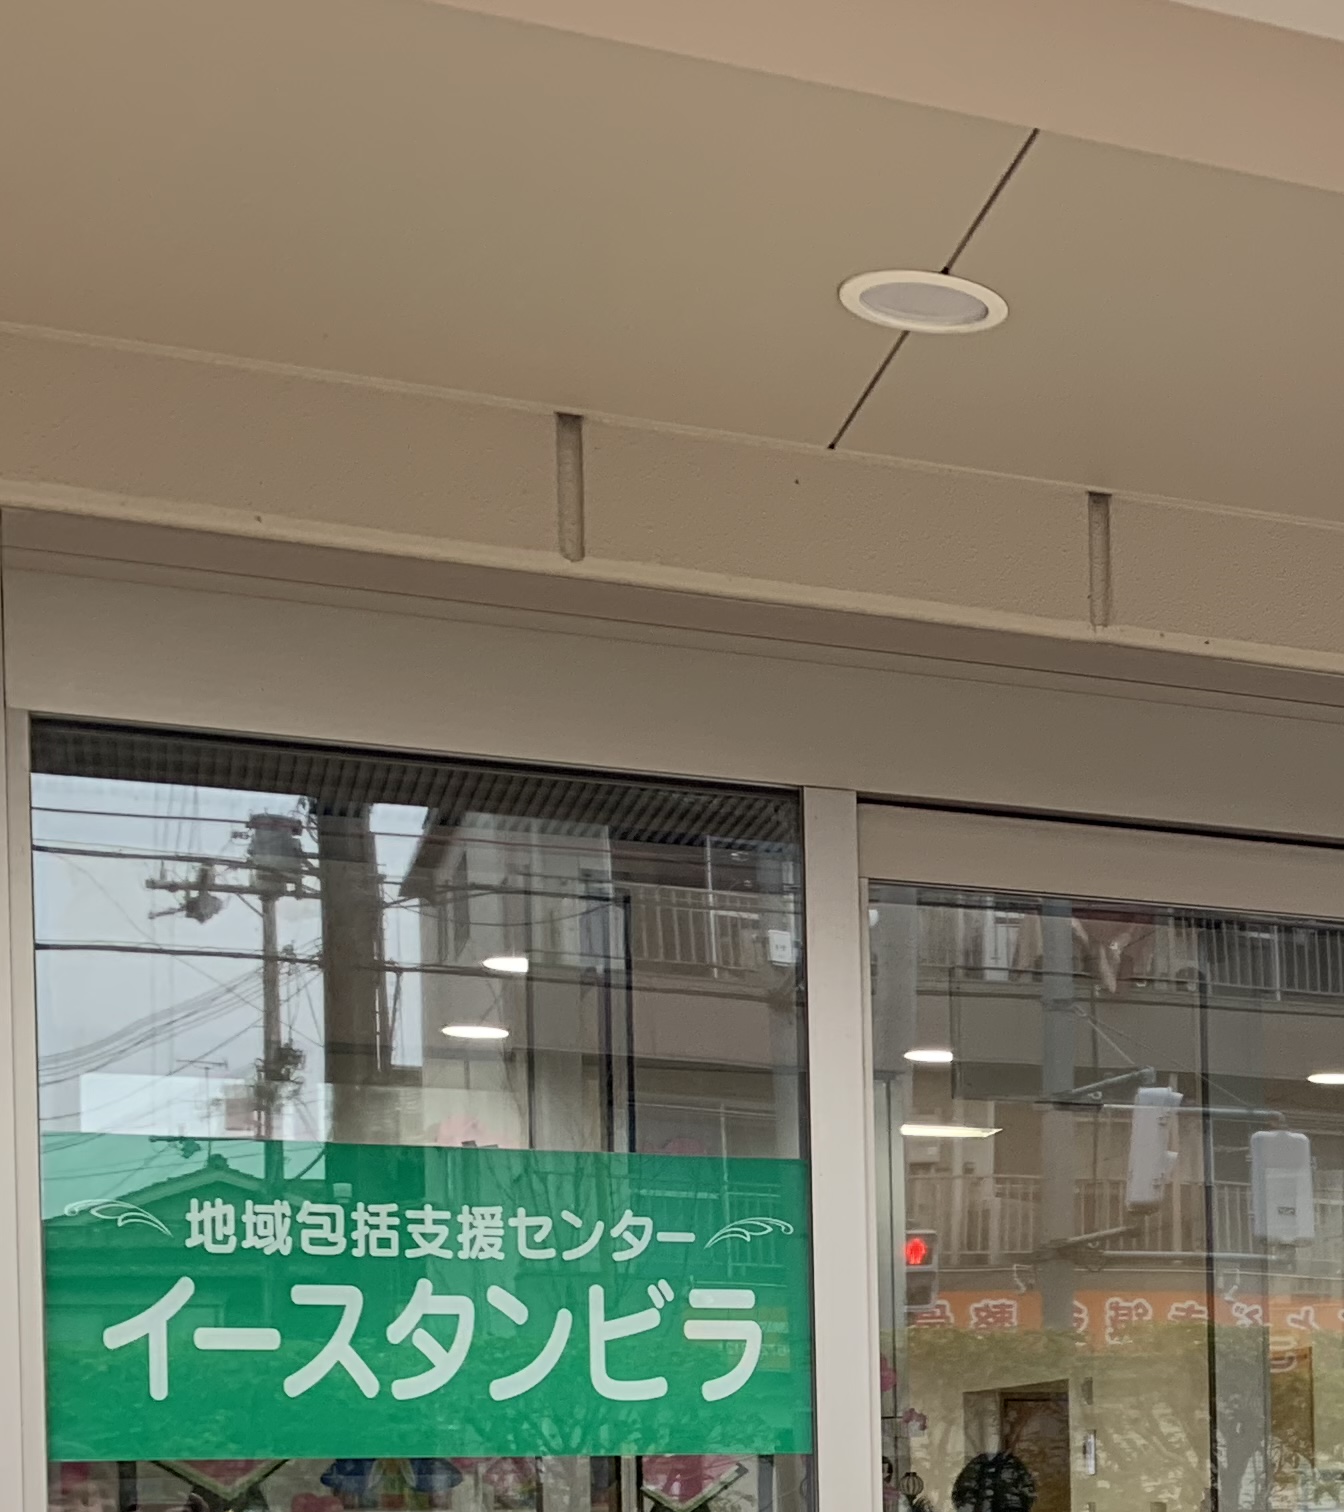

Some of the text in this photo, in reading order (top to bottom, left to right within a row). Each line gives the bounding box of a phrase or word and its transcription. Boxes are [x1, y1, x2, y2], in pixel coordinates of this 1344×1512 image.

[186, 1199, 697, 1262] 地域包括支援センター
[104, 1276, 763, 1402] イースタンビラ
